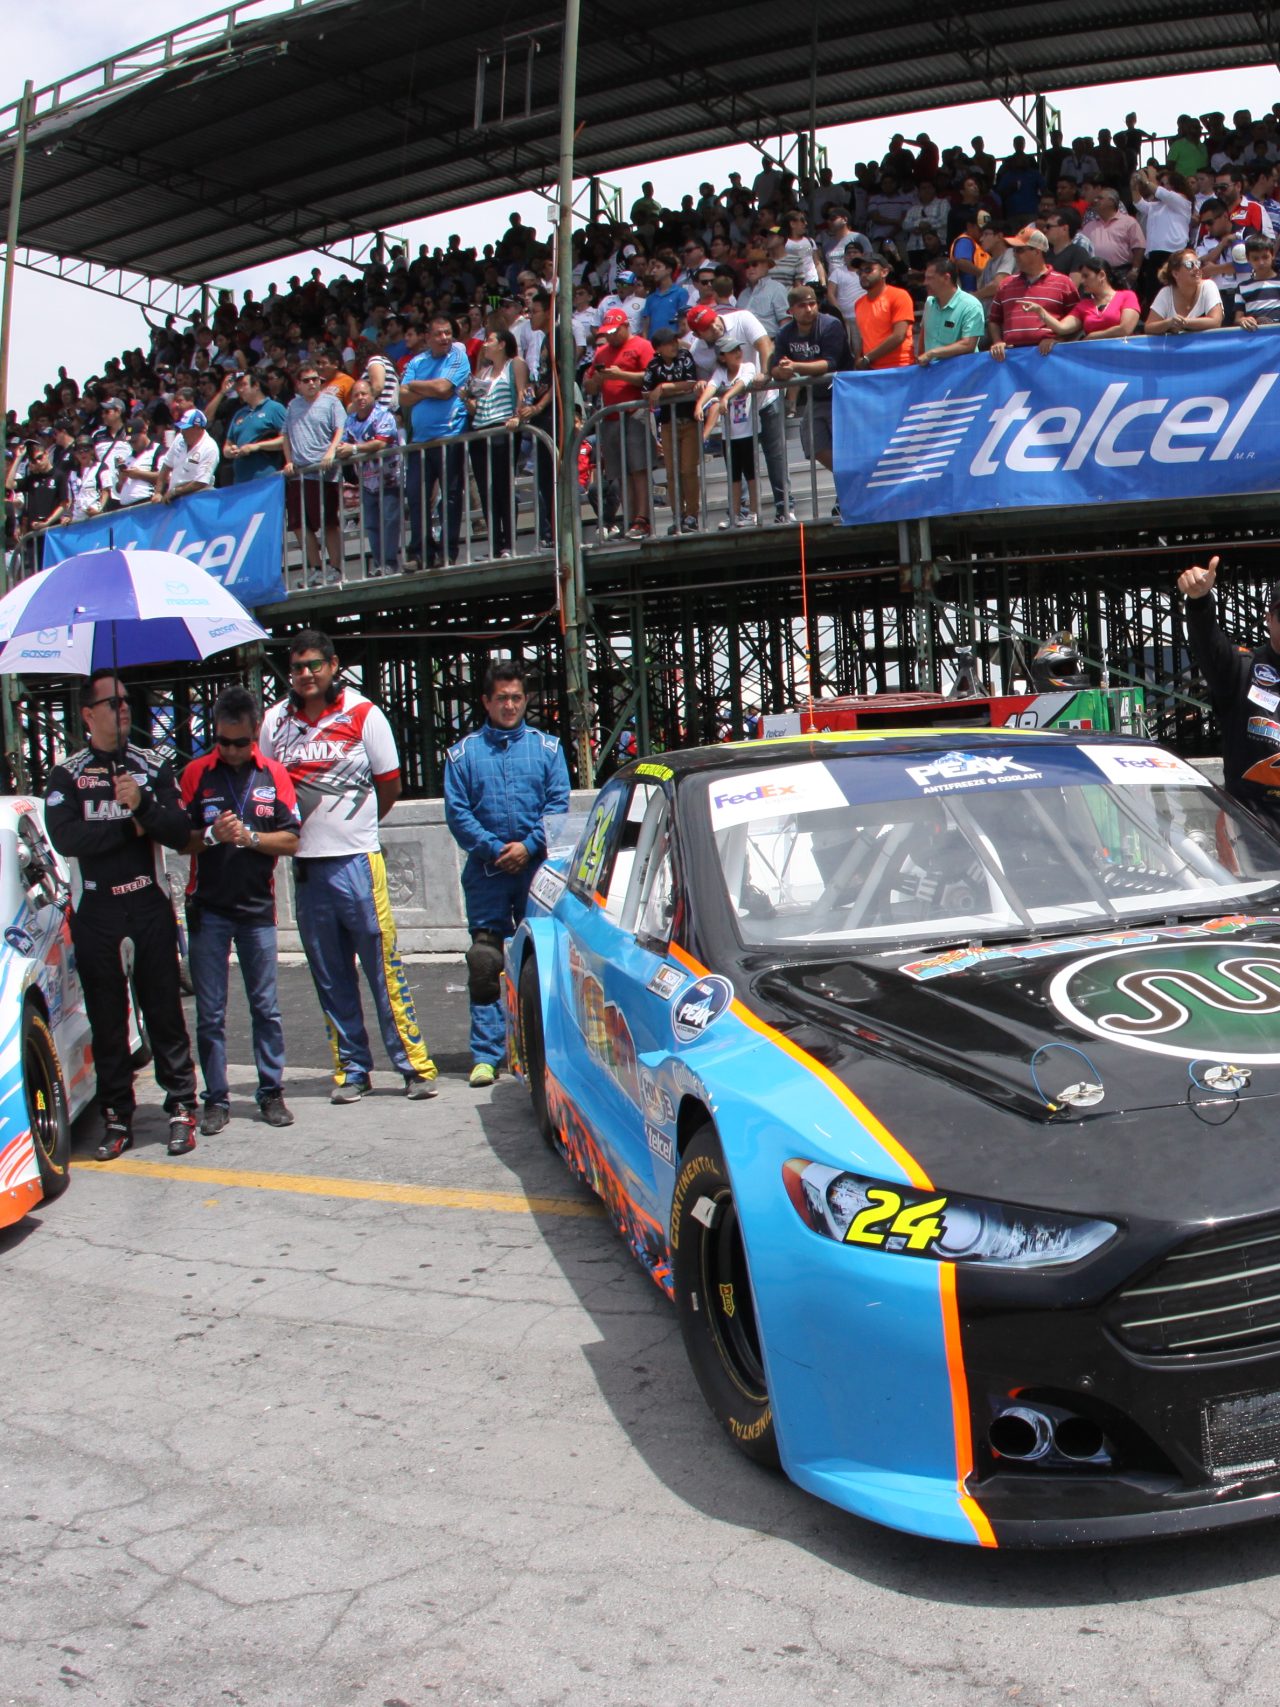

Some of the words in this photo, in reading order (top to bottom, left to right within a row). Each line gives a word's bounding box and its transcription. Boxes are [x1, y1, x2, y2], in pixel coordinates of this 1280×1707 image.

[969, 373, 1280, 477] telcel
[905, 756, 1035, 786] PEAK
[1113, 757, 1180, 769] FedEx
[714, 784, 797, 809] FedEx
[923, 778, 986, 794] ANTIFREEZE
[998, 772, 1043, 783] COOLANT
[678, 1002, 715, 1029] PEAK
[648, 1127, 673, 1161] telcel
[669, 1156, 720, 1249] CONTINENTAL
[845, 1189, 947, 1250] 24
